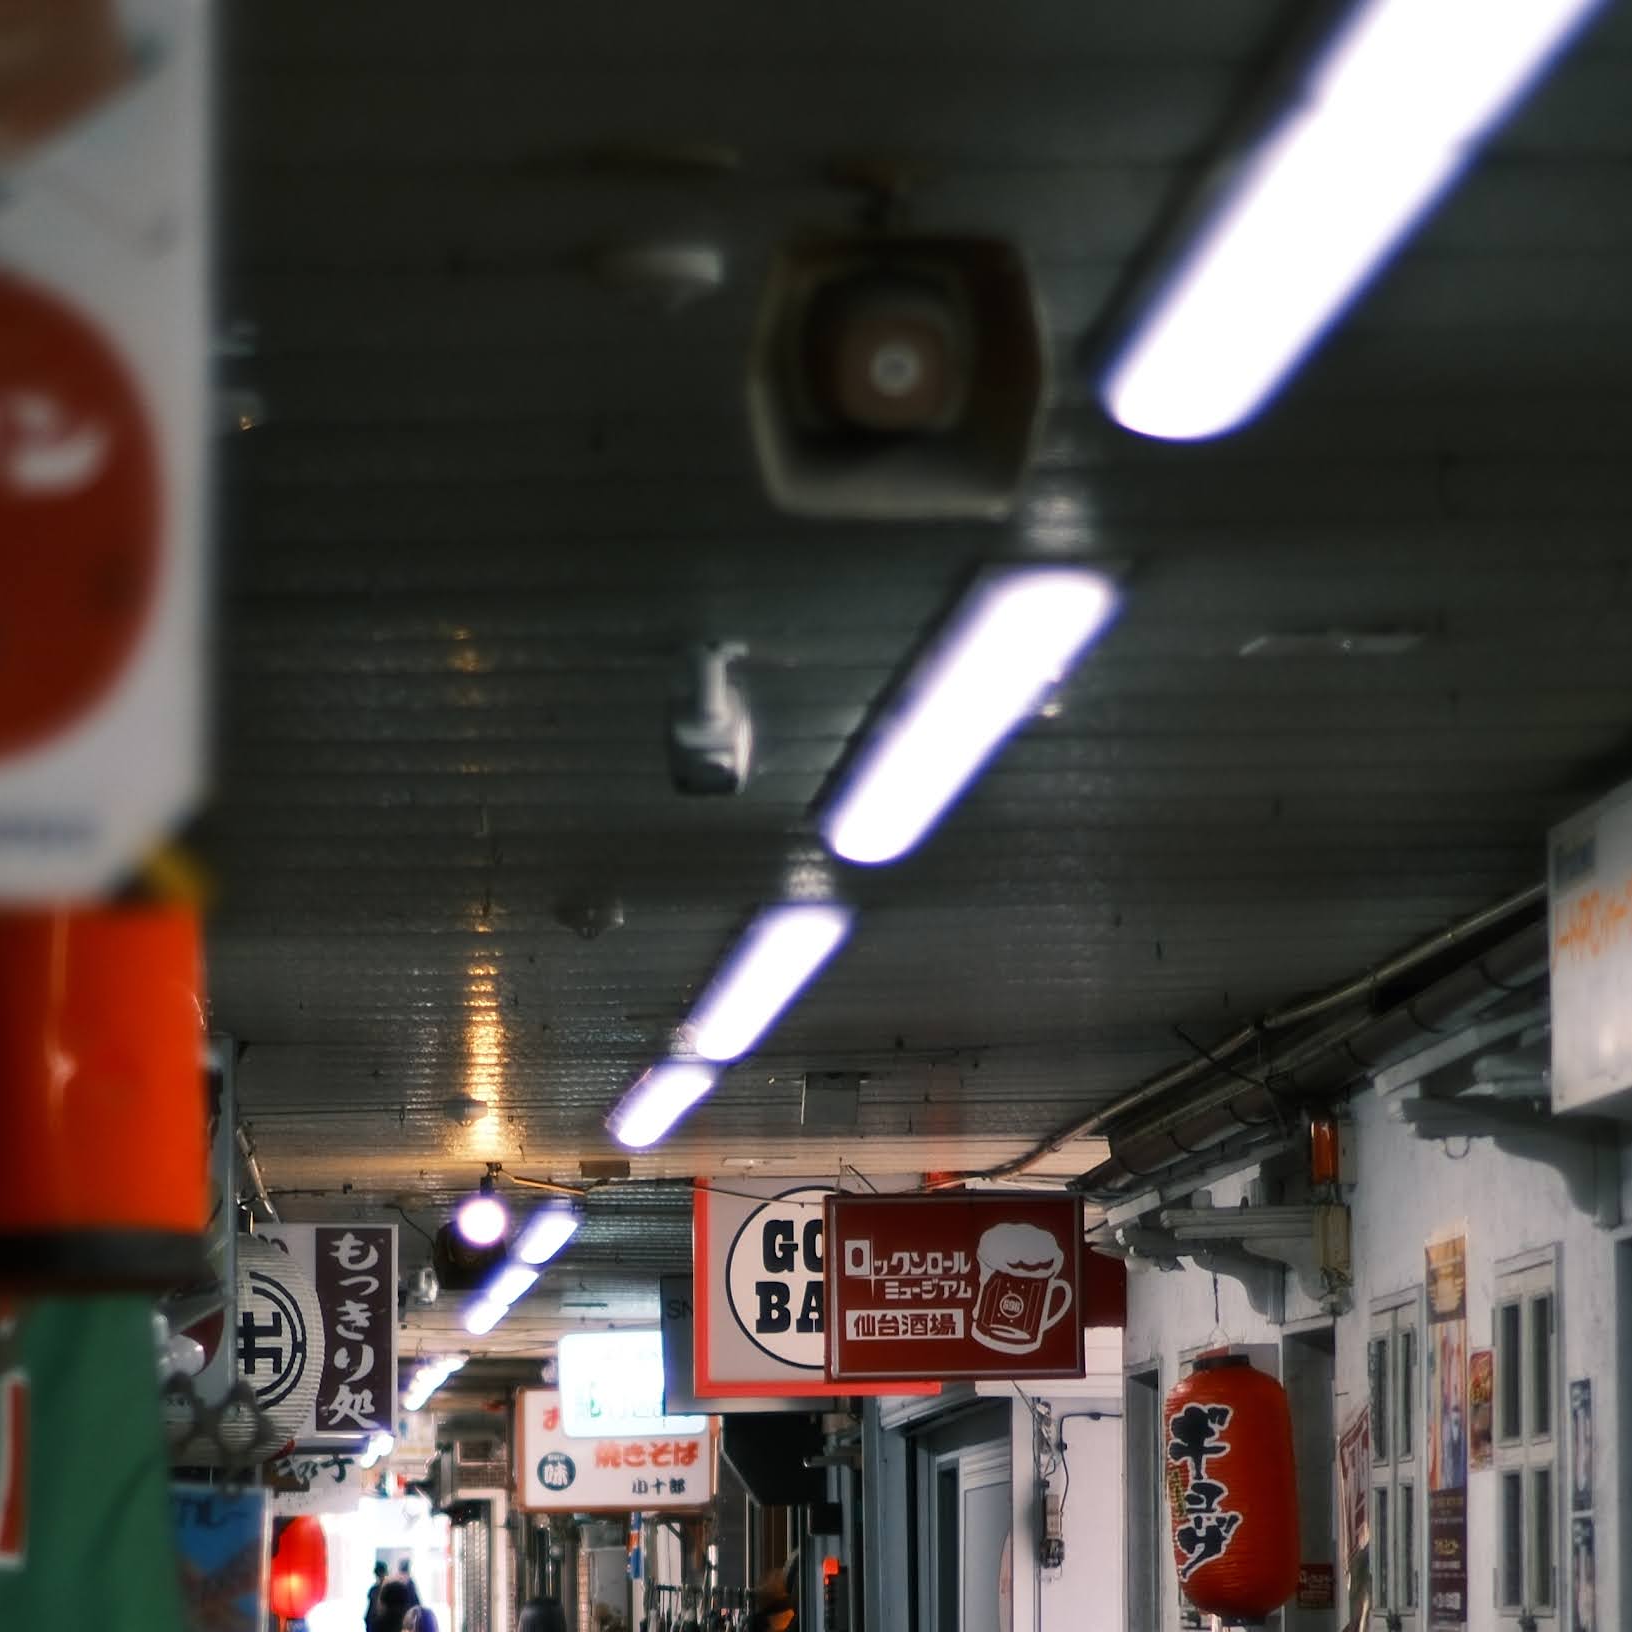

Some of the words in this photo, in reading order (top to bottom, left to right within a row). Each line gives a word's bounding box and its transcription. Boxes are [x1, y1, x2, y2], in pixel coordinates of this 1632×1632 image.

[844, 1239, 972, 1276] ロックンロール
[884, 1278, 973, 1300] ミュージアム
[328, 1231, 381, 1430] もっきり処
[853, 1312, 957, 1338] 仙台酒場
